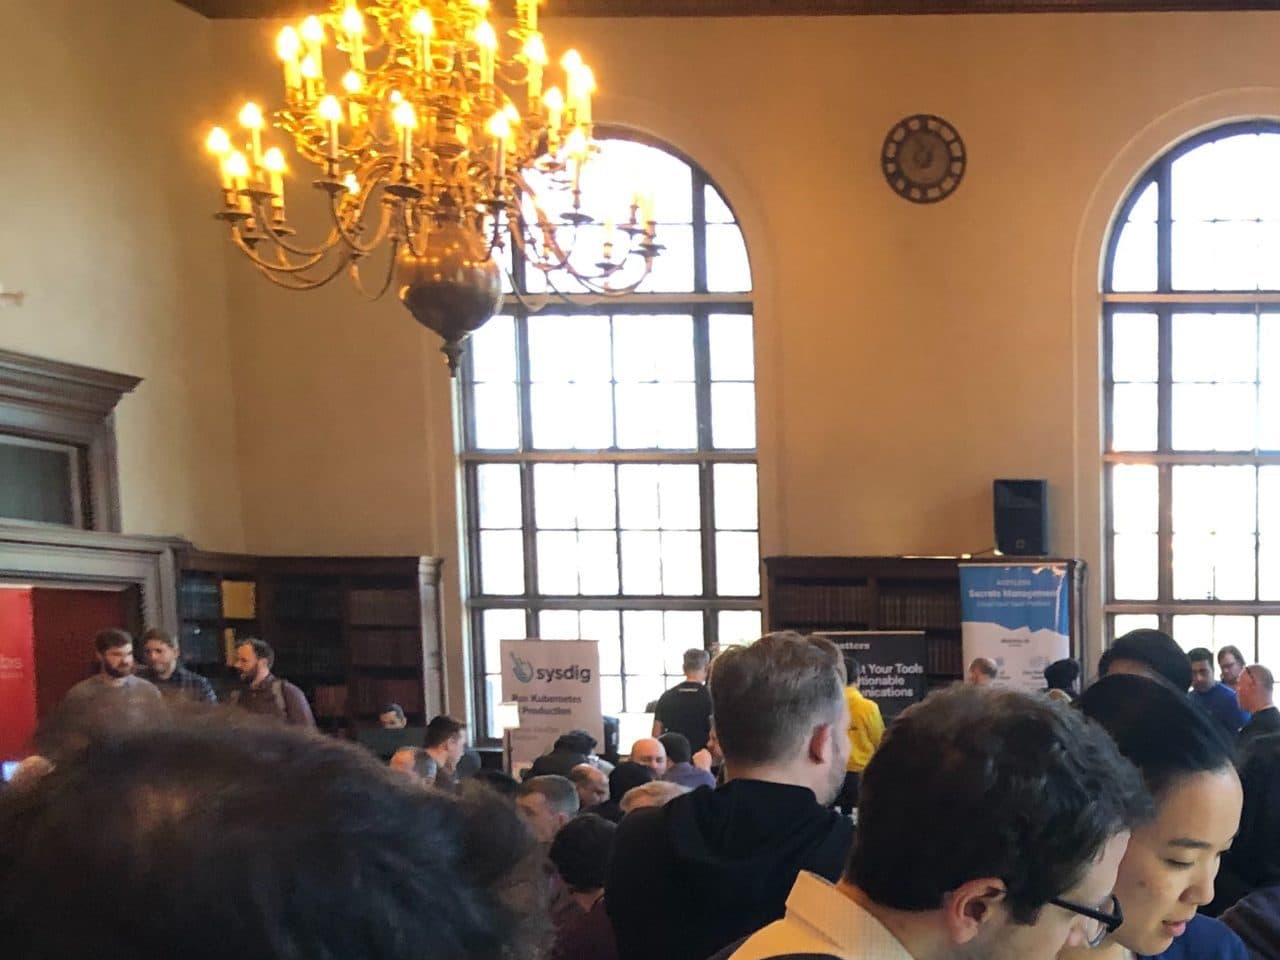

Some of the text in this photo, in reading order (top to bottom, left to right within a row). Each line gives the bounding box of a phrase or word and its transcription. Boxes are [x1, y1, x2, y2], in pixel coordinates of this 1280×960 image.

[536, 664, 591, 683] sysdig
[868, 664, 894, 674] Your
[894, 663, 924, 674] Tools
